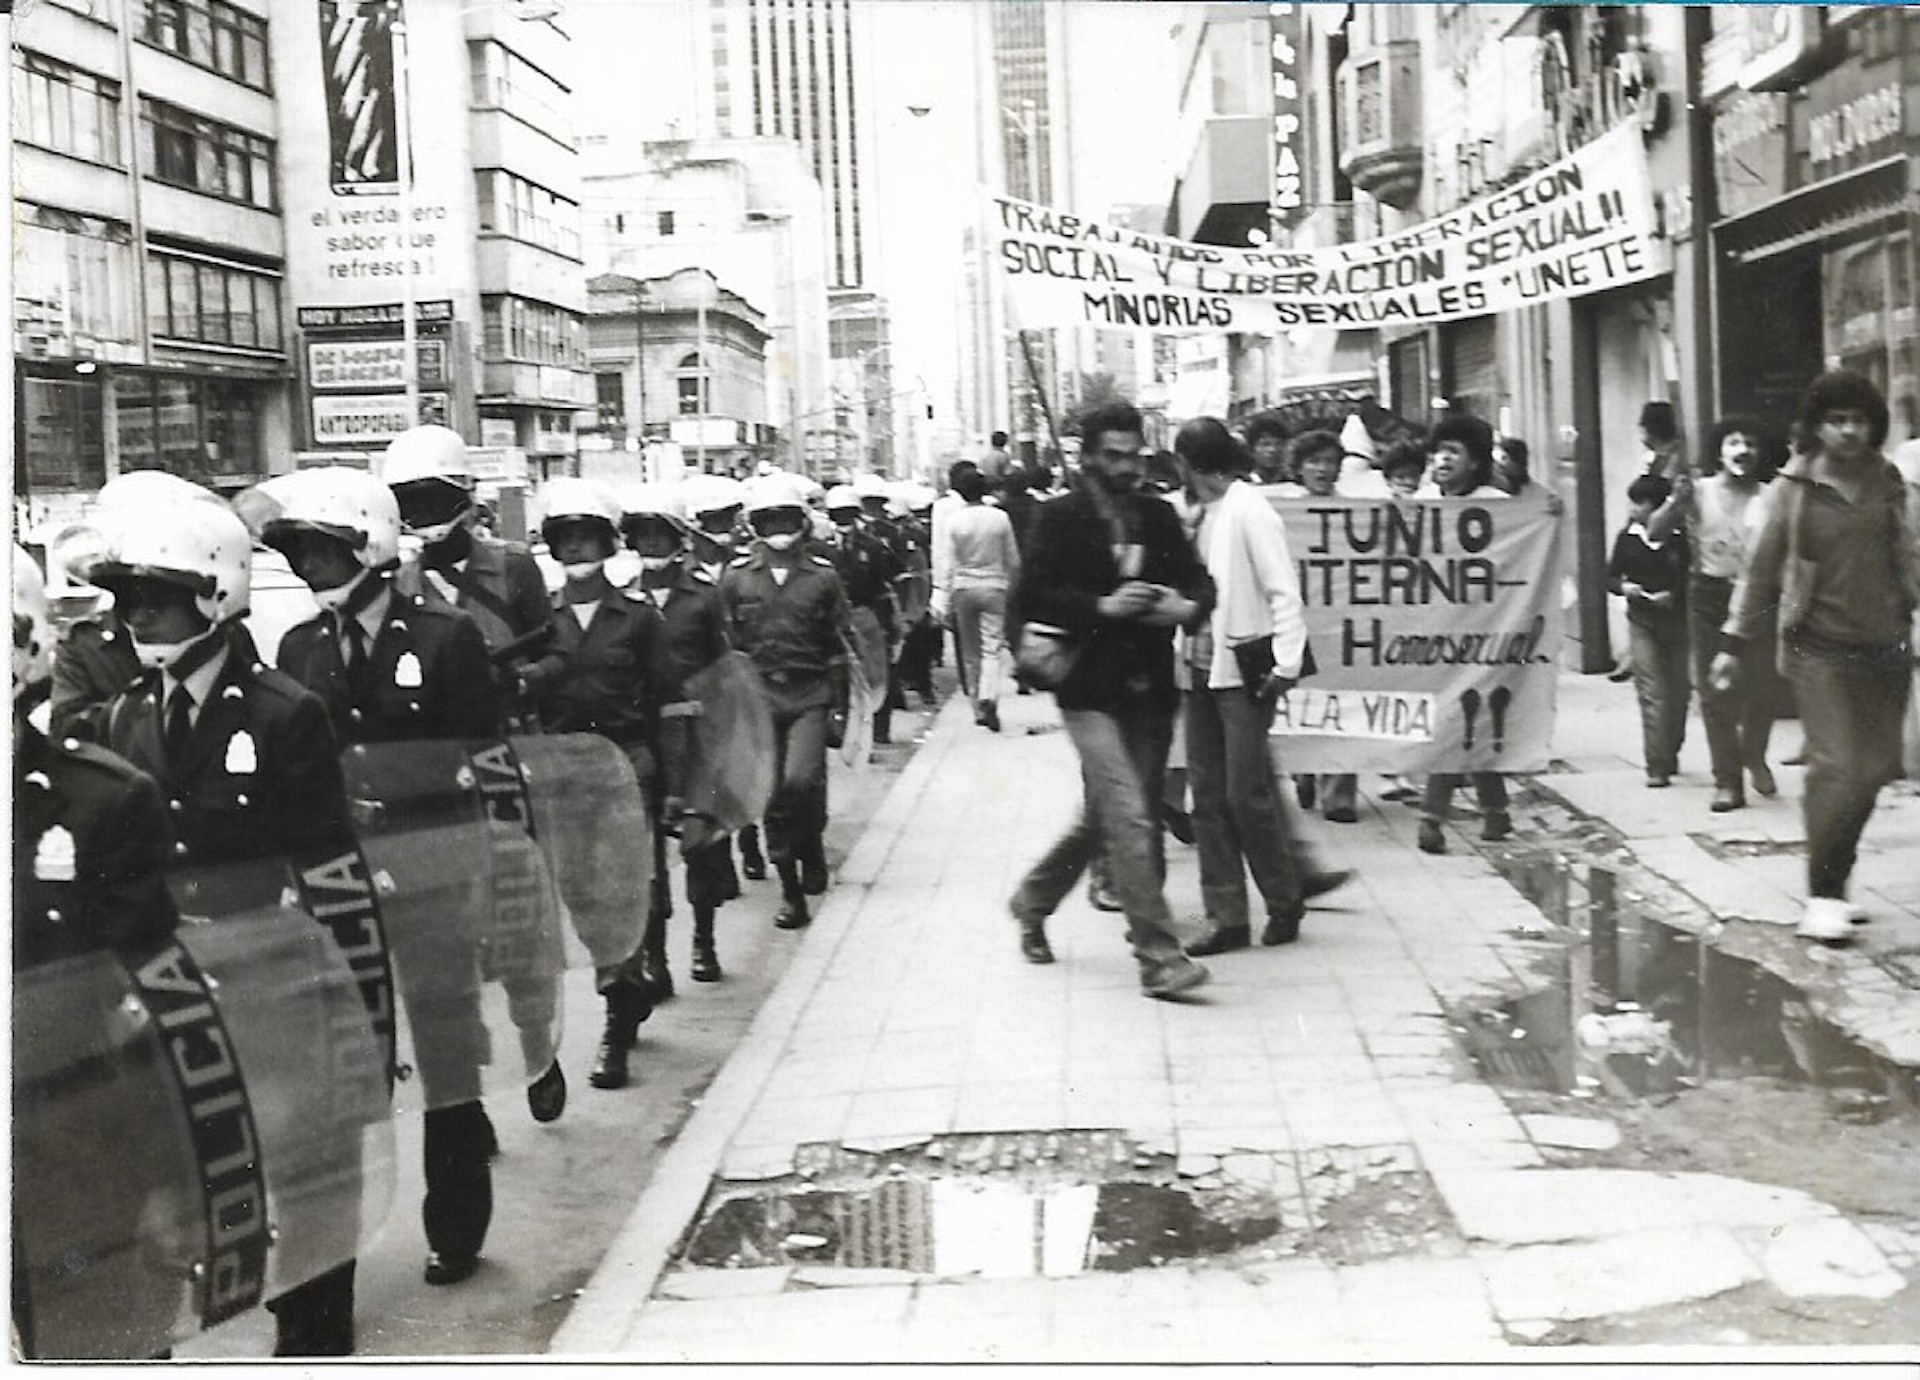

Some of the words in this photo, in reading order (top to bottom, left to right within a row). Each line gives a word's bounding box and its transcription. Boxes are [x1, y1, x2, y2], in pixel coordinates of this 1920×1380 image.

[311, 206, 330, 227] el
[340, 204, 447, 226] verdaero
[327, 232, 387, 252] sabor
[396, 232, 436, 250] ue
[1001, 239, 1134, 283] SOCIAL
[1153, 257, 1174, 286] Y
[1199, 249, 1445, 295] LIBERACION
[1466, 189, 1629, 271] SEXUAL!!
[1243, 253, 1314, 269] POR
[1083, 286, 1232, 326] MINORIAS
[1274, 281, 1486, 324] SEXUALES
[1306, 501, 1494, 557] JUNIO
[1362, 694, 1431, 736] VIDA
[136, 945, 260, 1306] POLICIA
